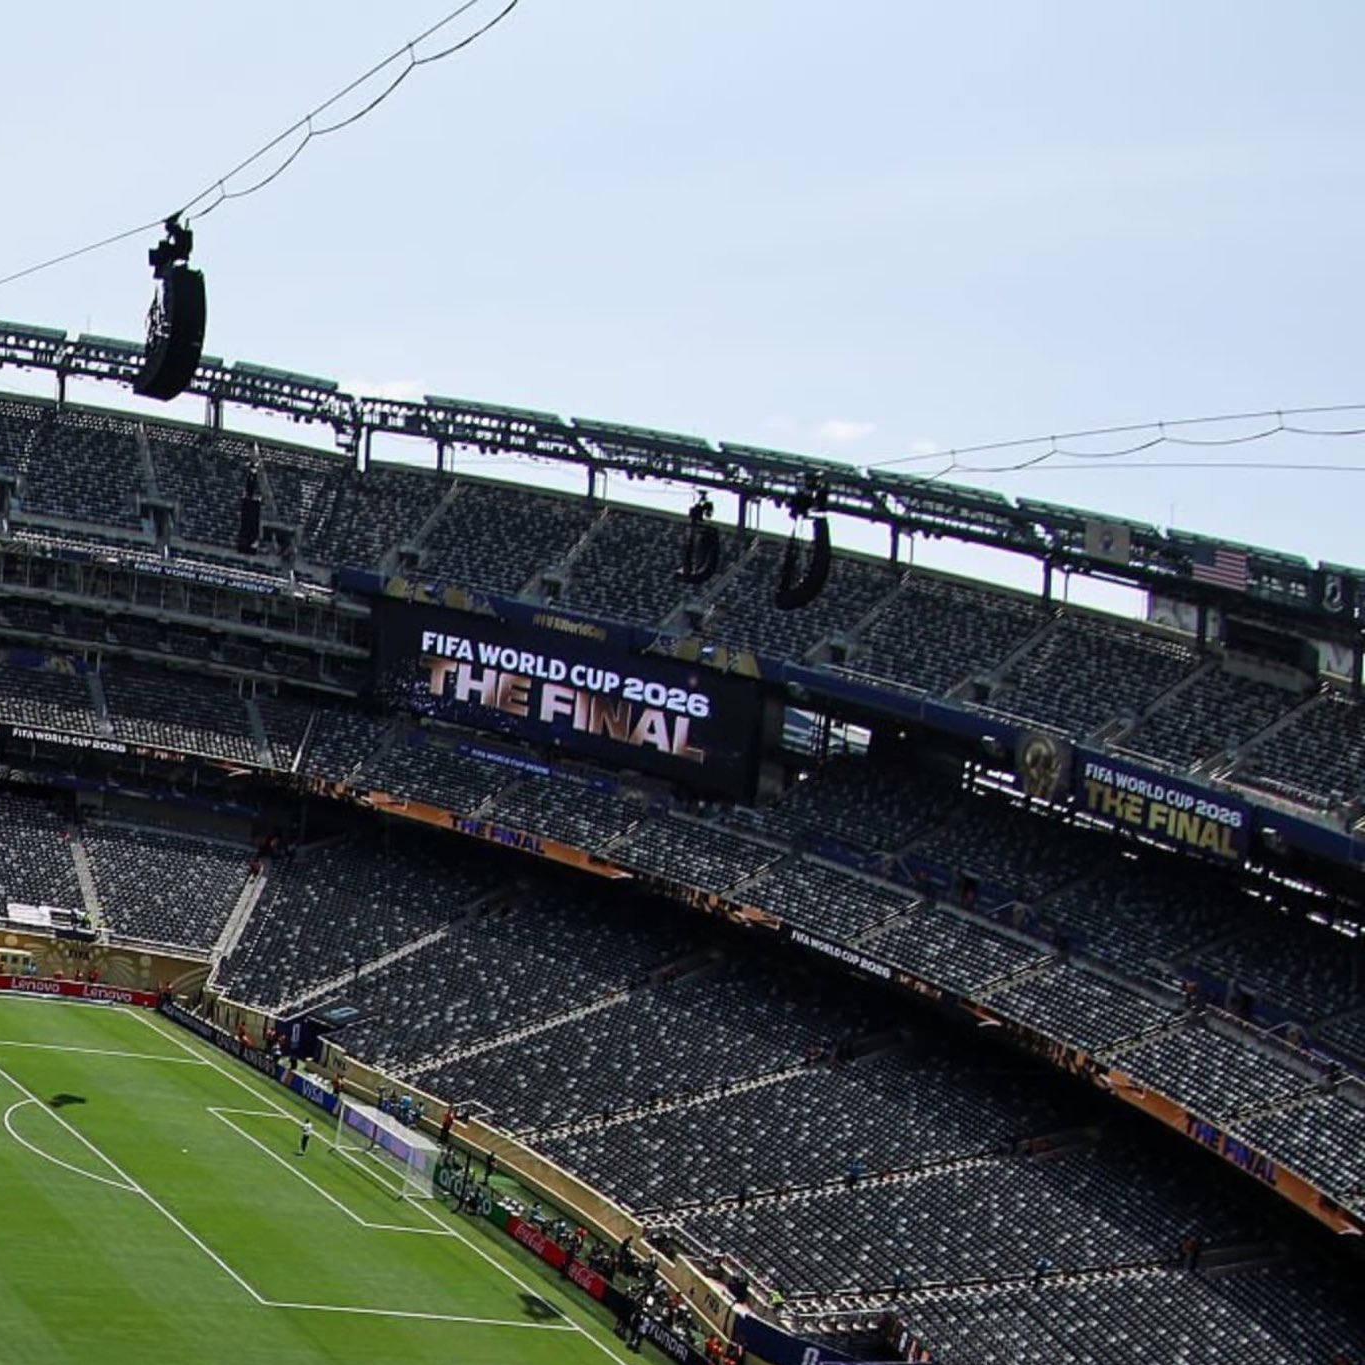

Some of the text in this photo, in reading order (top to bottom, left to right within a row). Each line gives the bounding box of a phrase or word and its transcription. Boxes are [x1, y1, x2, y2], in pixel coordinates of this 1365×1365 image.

[421, 630, 710, 718] FIFA WORLD CUP 2026
[12, 728, 126, 753] FIFA WORLD CUP 2026
[421, 654, 705, 765] THE FINAL
[1084, 779, 1239, 859] THE FINAL
[1085, 763, 1242, 827] FIFA WORLD CUP 2026
[11, 977, 60, 993] Lenovo
[83, 985, 132, 1003] Lenovo
